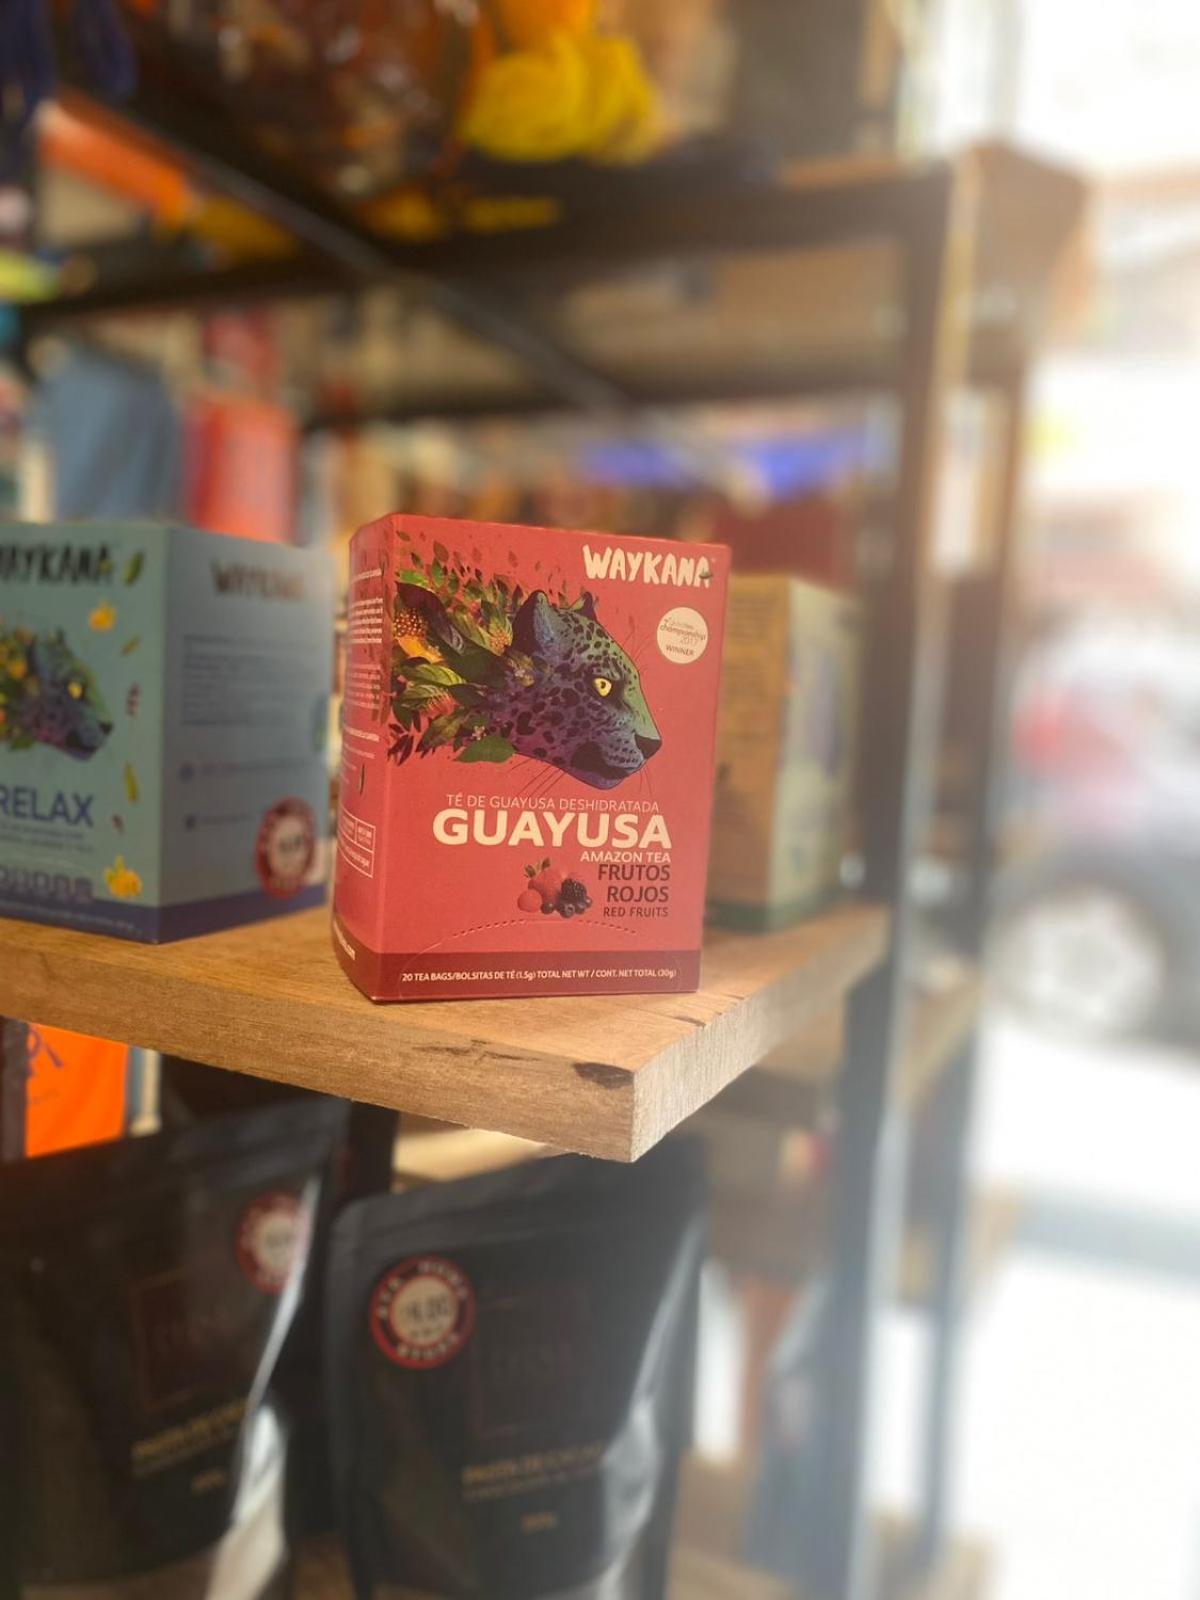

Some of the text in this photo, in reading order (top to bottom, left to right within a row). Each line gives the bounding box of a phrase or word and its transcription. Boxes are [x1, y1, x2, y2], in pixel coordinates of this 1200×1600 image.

[0, 542, 112, 586] AYKANA
[582, 544, 710, 588] WAYKANA
[666, 644, 694, 656] WINNER
[0, 783, 94, 828] RELAX
[447, 792, 660, 813] TÉ DE GUAYUSA DESHIDRATADA
[432, 808, 672, 849] GUAYUSA
[580, 850, 671, 863] AMAZON TEA
[598, 863, 670, 882] FRUTOS
[607, 886, 669, 903] ROJOS
[603, 906, 669, 918] RED FRUITS
[402, 972, 414, 982] 20
[415, 972, 430, 981] TEA
[431, 970, 493, 981] BAGS/BOLSITAS
[494, 970, 504, 980] DE
[506, 969, 515, 980] TÉ
[537, 969, 560, 979] TOTAL
[562, 969, 577, 979] NET
[578, 969, 590, 979] WT
[595, 969, 617, 978] CONT.
[618, 968, 633, 978] NET
[634, 968, 656, 978] TOTAL
